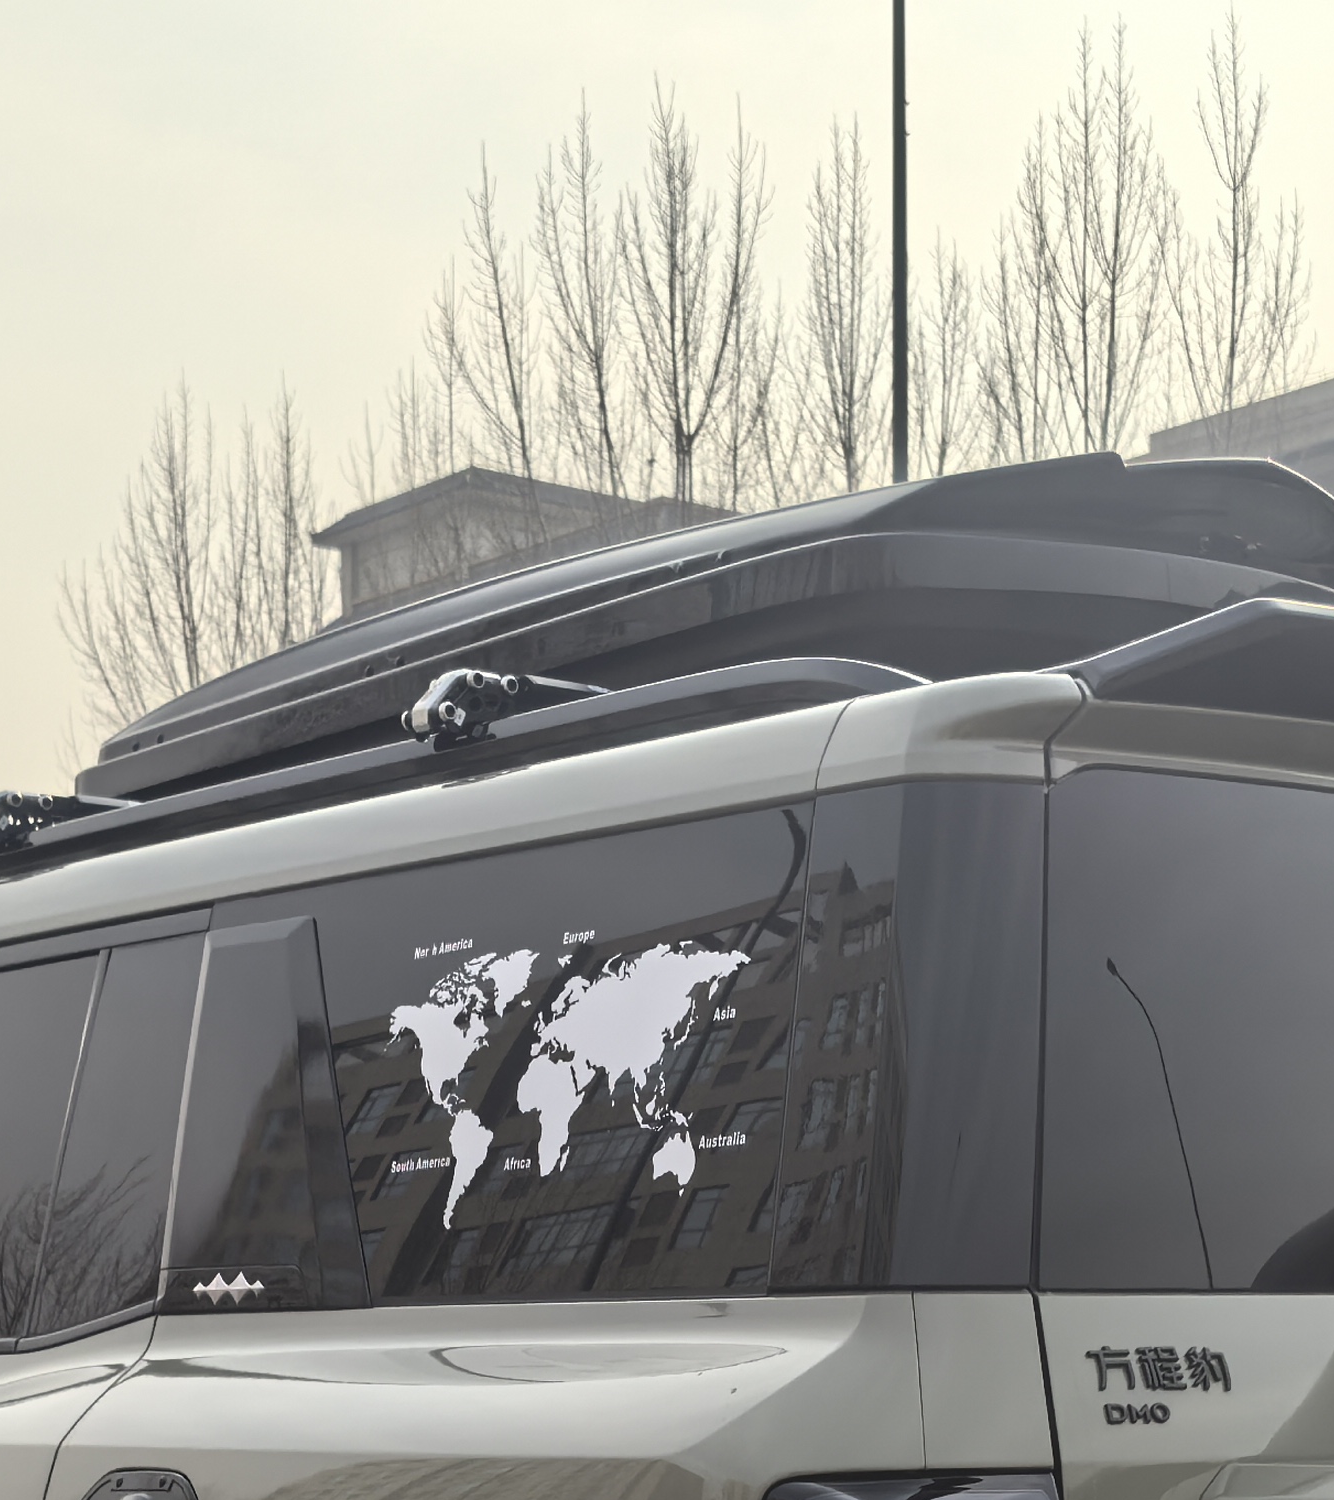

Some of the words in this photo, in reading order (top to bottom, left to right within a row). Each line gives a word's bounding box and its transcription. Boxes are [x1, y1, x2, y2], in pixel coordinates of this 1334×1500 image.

[563, 929, 596, 945] Europe
[438, 938, 473, 955] America
[712, 1006, 736, 1022] Asia
[698, 1131, 746, 1150] Australia
[390, 1159, 415, 1173] South
[416, 1156, 451, 1170] America
[503, 1157, 532, 1171] Africa
[1085, 1346, 1232, 1392] 方程豹
[1103, 1403, 1170, 1424] DMO
